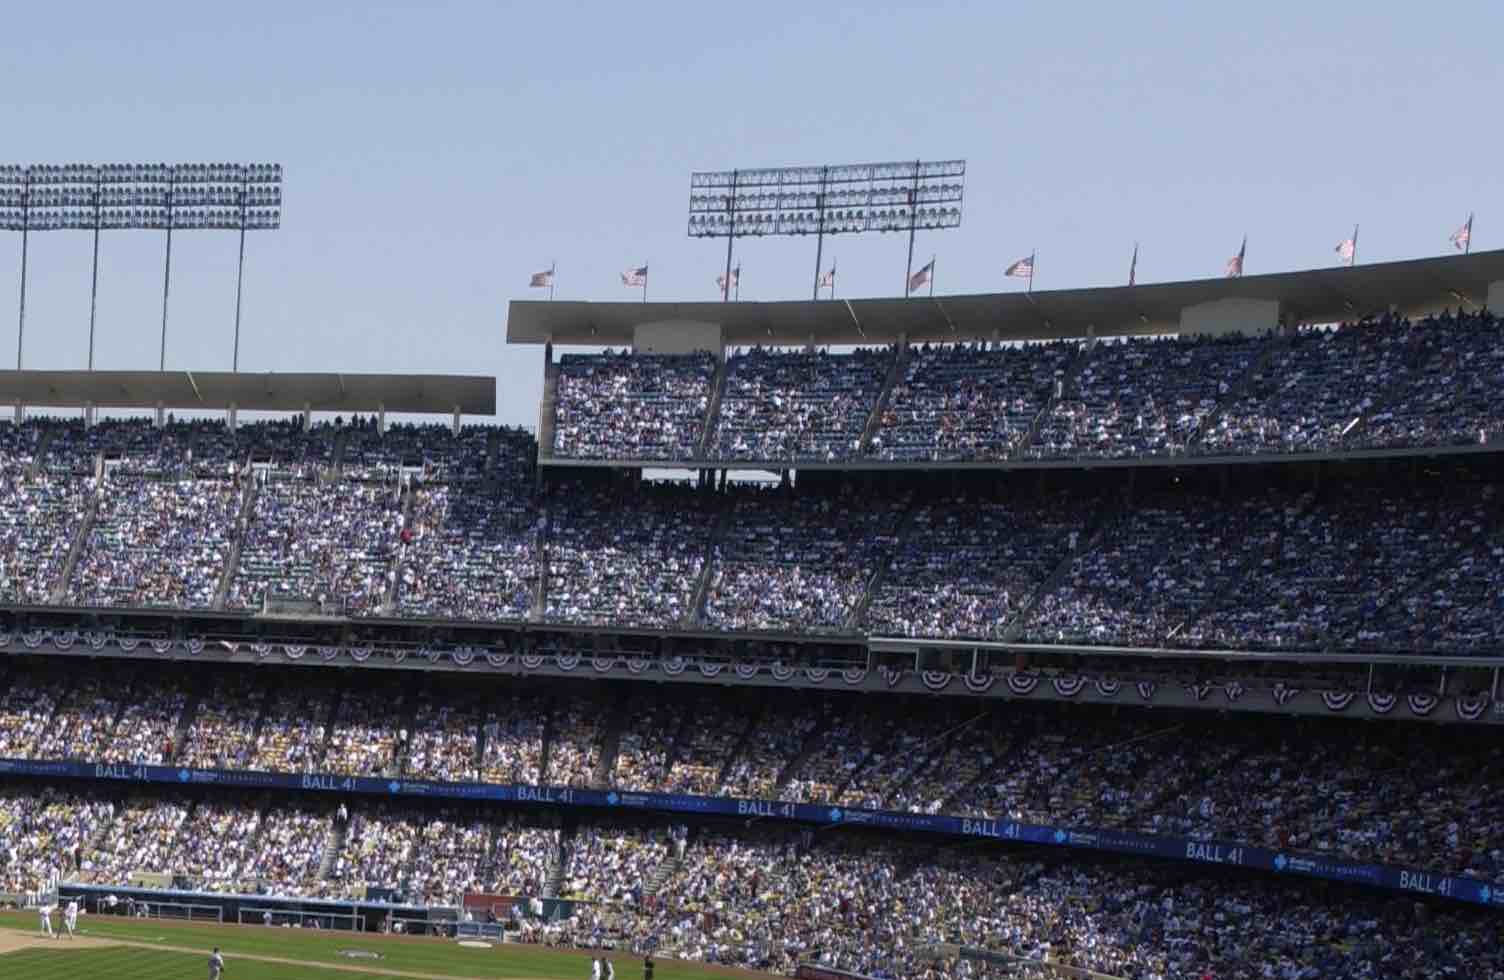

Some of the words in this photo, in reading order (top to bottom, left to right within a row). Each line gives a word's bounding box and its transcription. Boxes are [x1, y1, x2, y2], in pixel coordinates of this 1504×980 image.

[96, 764, 129, 778] BALL
[302, 776, 336, 790] BALL
[518, 786, 554, 801] BALL
[738, 800, 775, 816] BALL
[962, 820, 1000, 837] BALL
[1186, 843, 1222, 862] BALL
[1400, 871, 1434, 893] BALL
